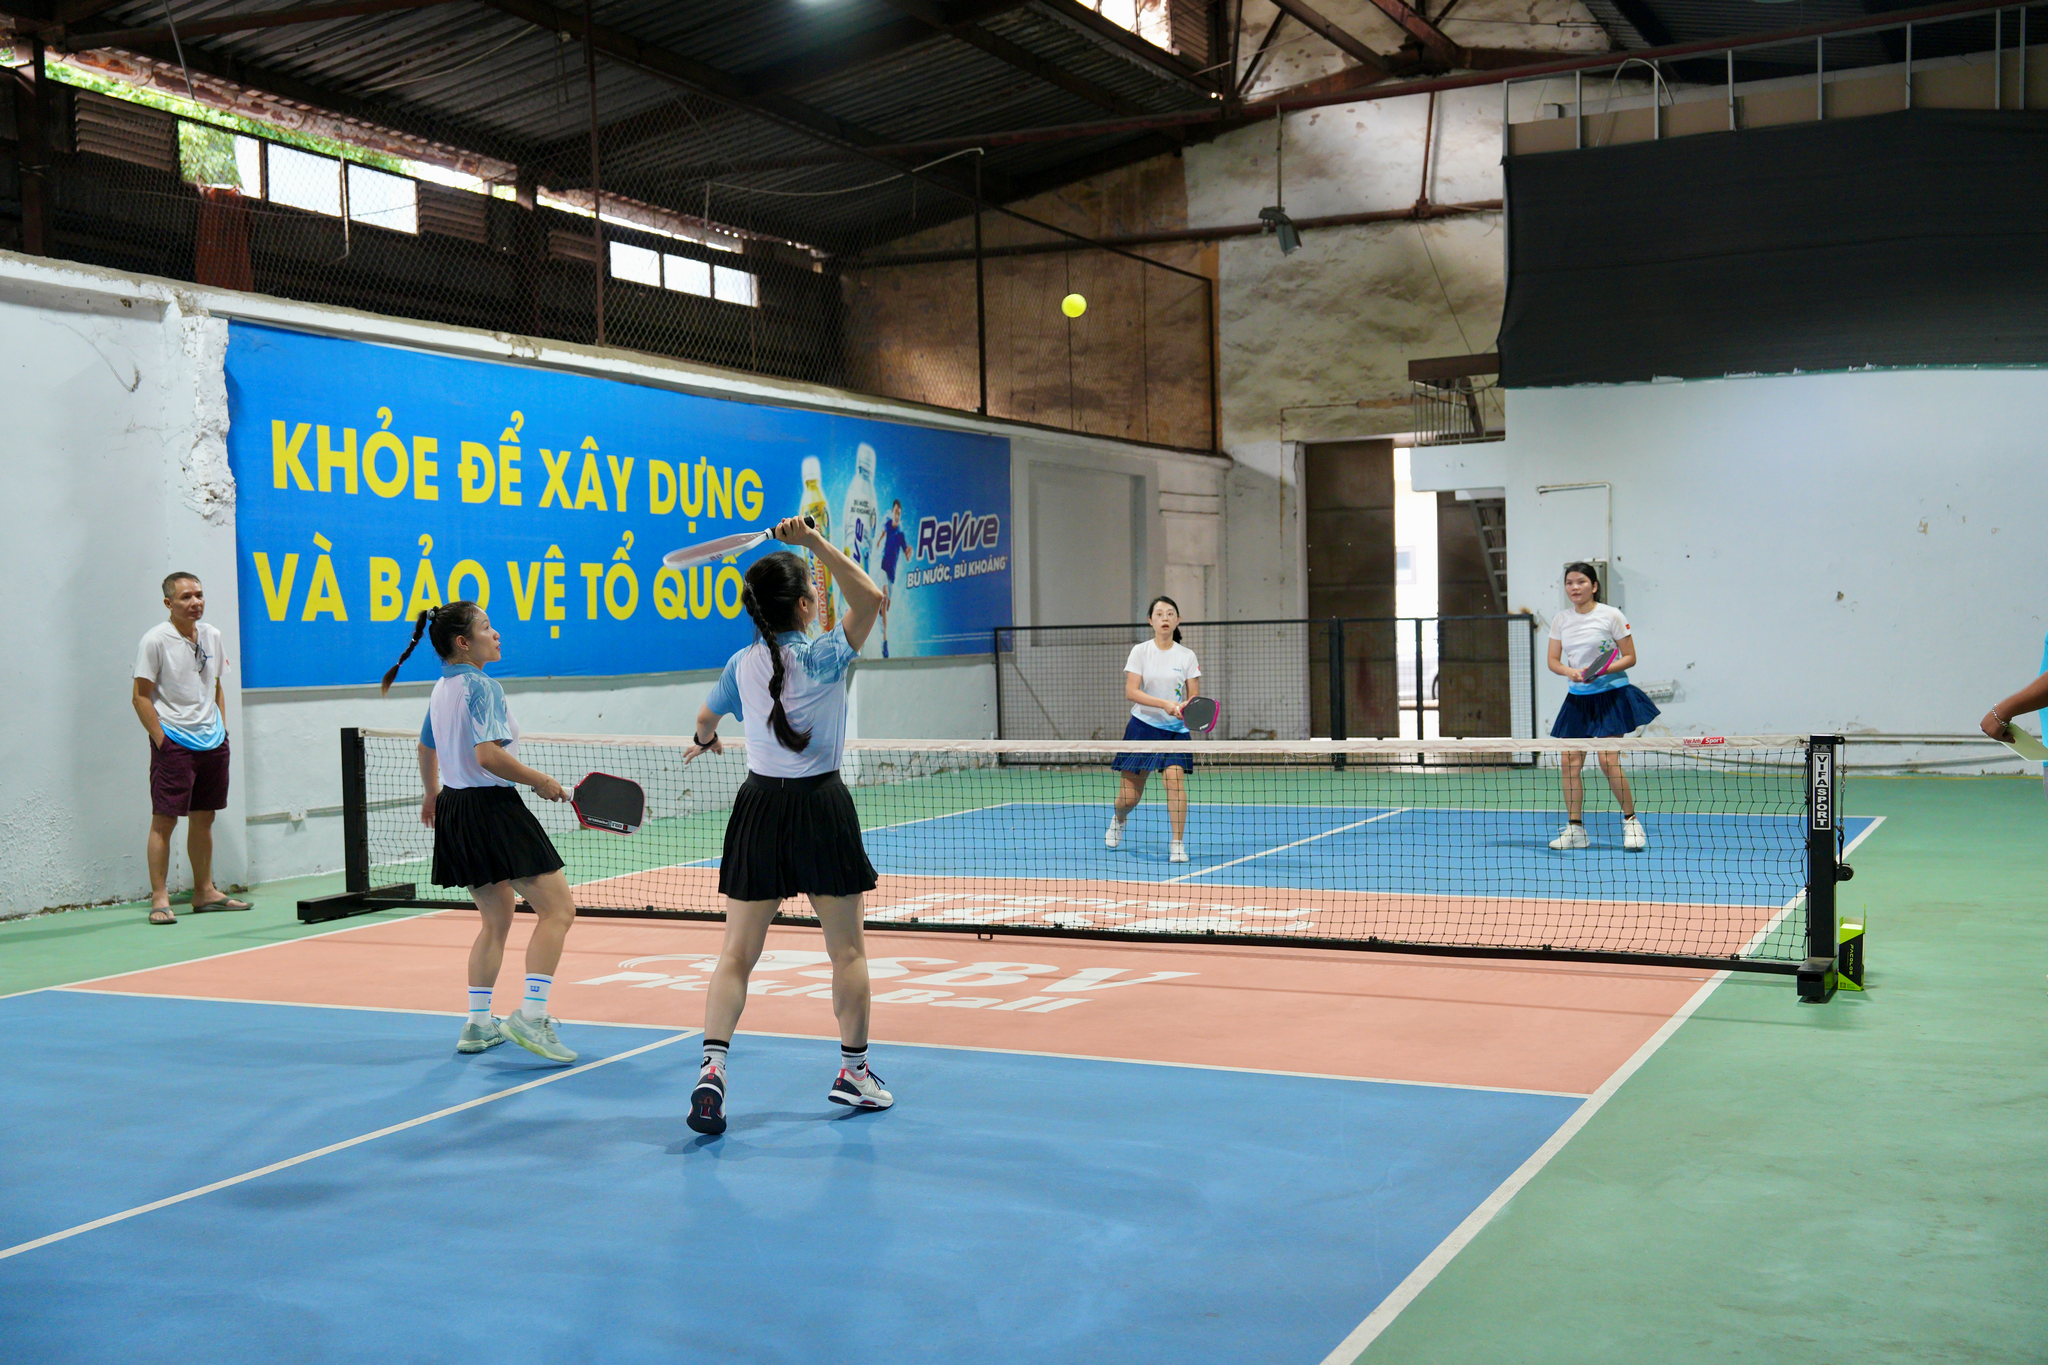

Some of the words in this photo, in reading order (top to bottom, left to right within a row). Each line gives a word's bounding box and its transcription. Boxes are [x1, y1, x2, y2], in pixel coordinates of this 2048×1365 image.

[272, 406, 439, 499] KHỎE
[457, 410, 523, 505] ĐỂ
[539, 436, 634, 511] XÂY
[649, 456, 764, 533] DỰNG
[253, 532, 348, 621] VÀ
[370, 534, 490, 621] BẢO
[507, 545, 565, 639] VỆ
[581, 530, 639, 620] TỔ
[653, 553, 744, 620] QUỐ
[907, 567, 921, 589] BÙ
[954, 560, 967, 580] BÙ
